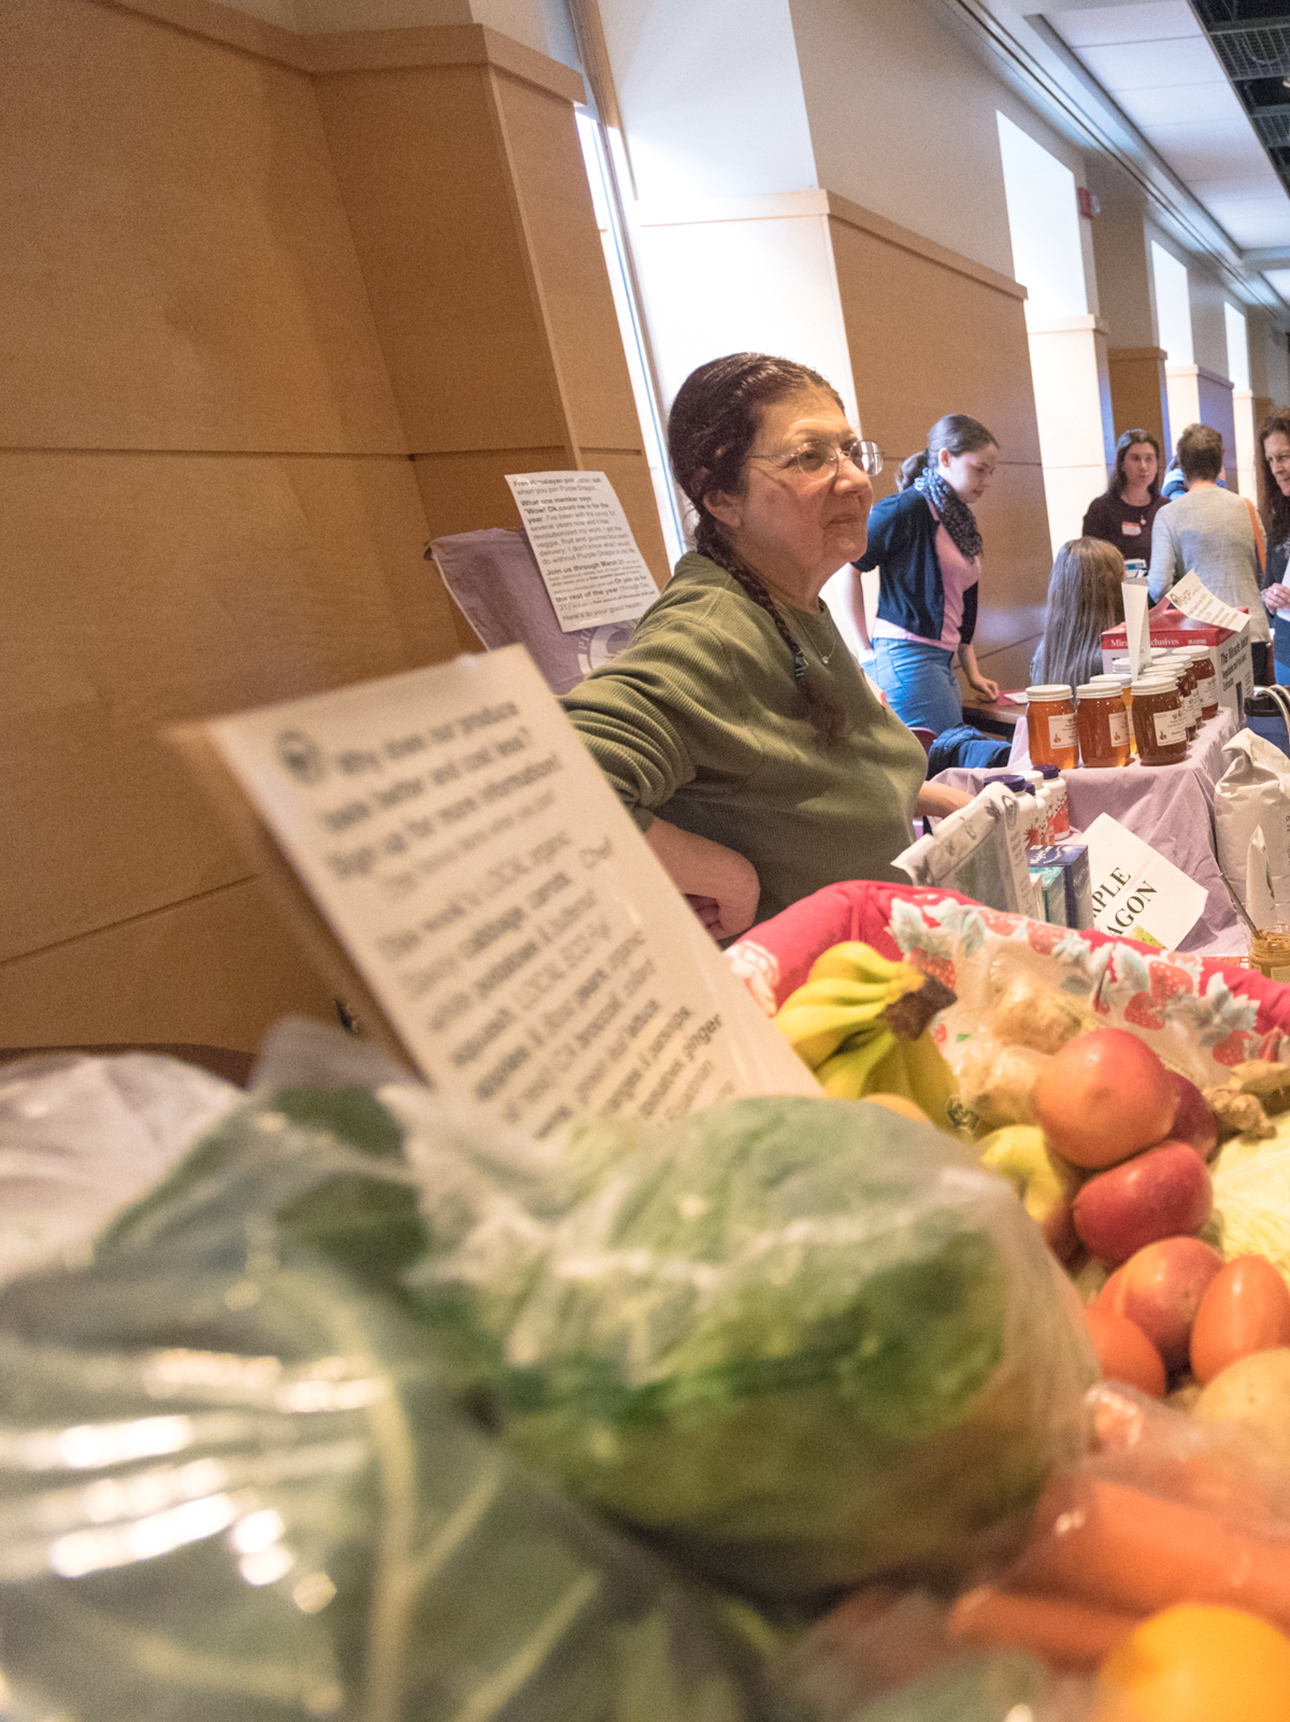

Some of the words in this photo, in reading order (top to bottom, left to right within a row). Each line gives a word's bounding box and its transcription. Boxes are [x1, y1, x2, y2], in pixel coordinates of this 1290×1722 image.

[545, 567, 562, 576] Join
[572, 561, 600, 571] through
[568, 592, 583, 600] rest
